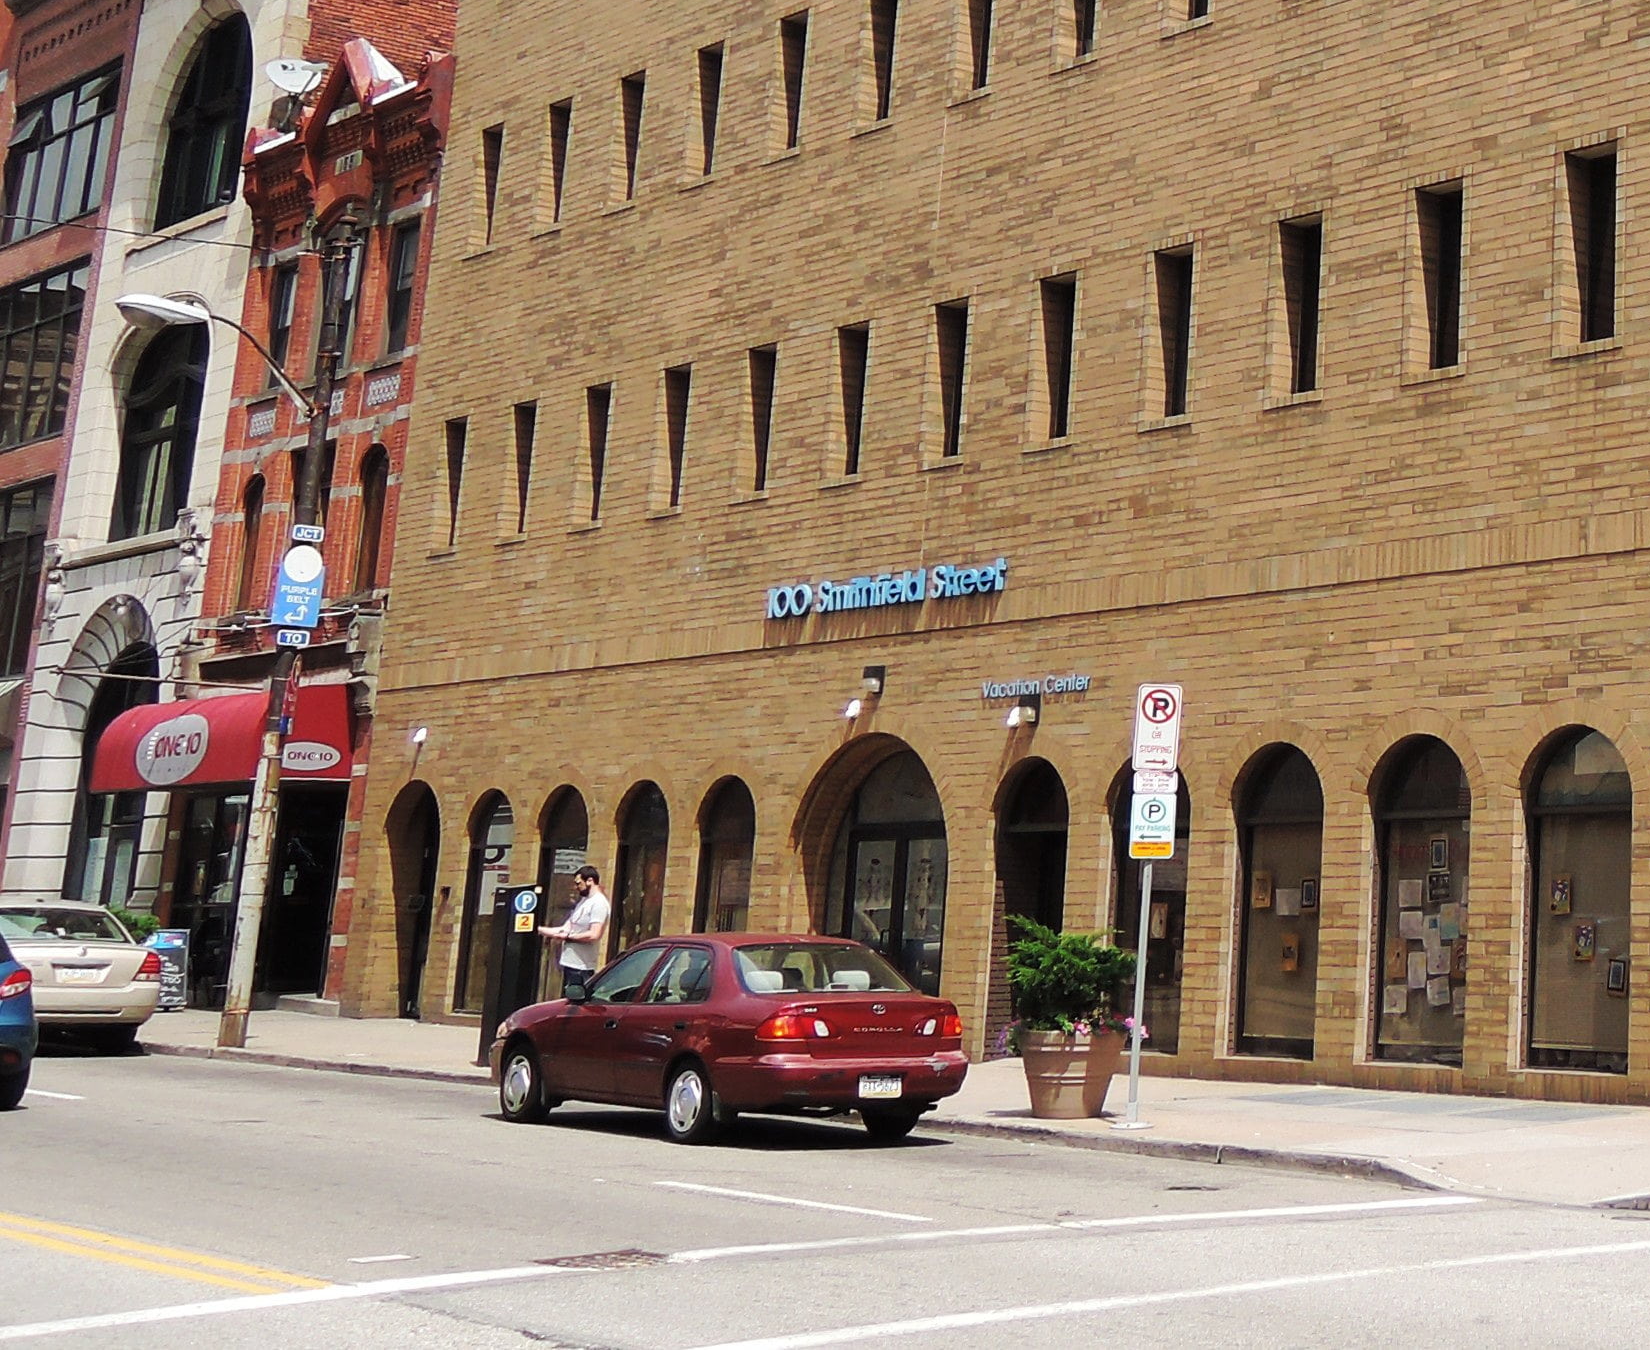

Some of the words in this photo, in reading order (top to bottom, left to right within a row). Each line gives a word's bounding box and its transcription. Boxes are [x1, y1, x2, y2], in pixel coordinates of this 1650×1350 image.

[296, 528, 320, 540] JCT
[280, 584, 318, 596] PURPLE
[767, 583, 812, 619] 100
[816, 568, 926, 613] Smithfield
[931, 557, 1008, 599] Street
[286, 595, 311, 604] BELT
[283, 633, 302, 644] TO
[982, 679, 1040, 698] Vacation
[1044, 674, 1092, 694] Center
[1148, 804, 1161, 819] P
[520, 915, 530, 927] 2
